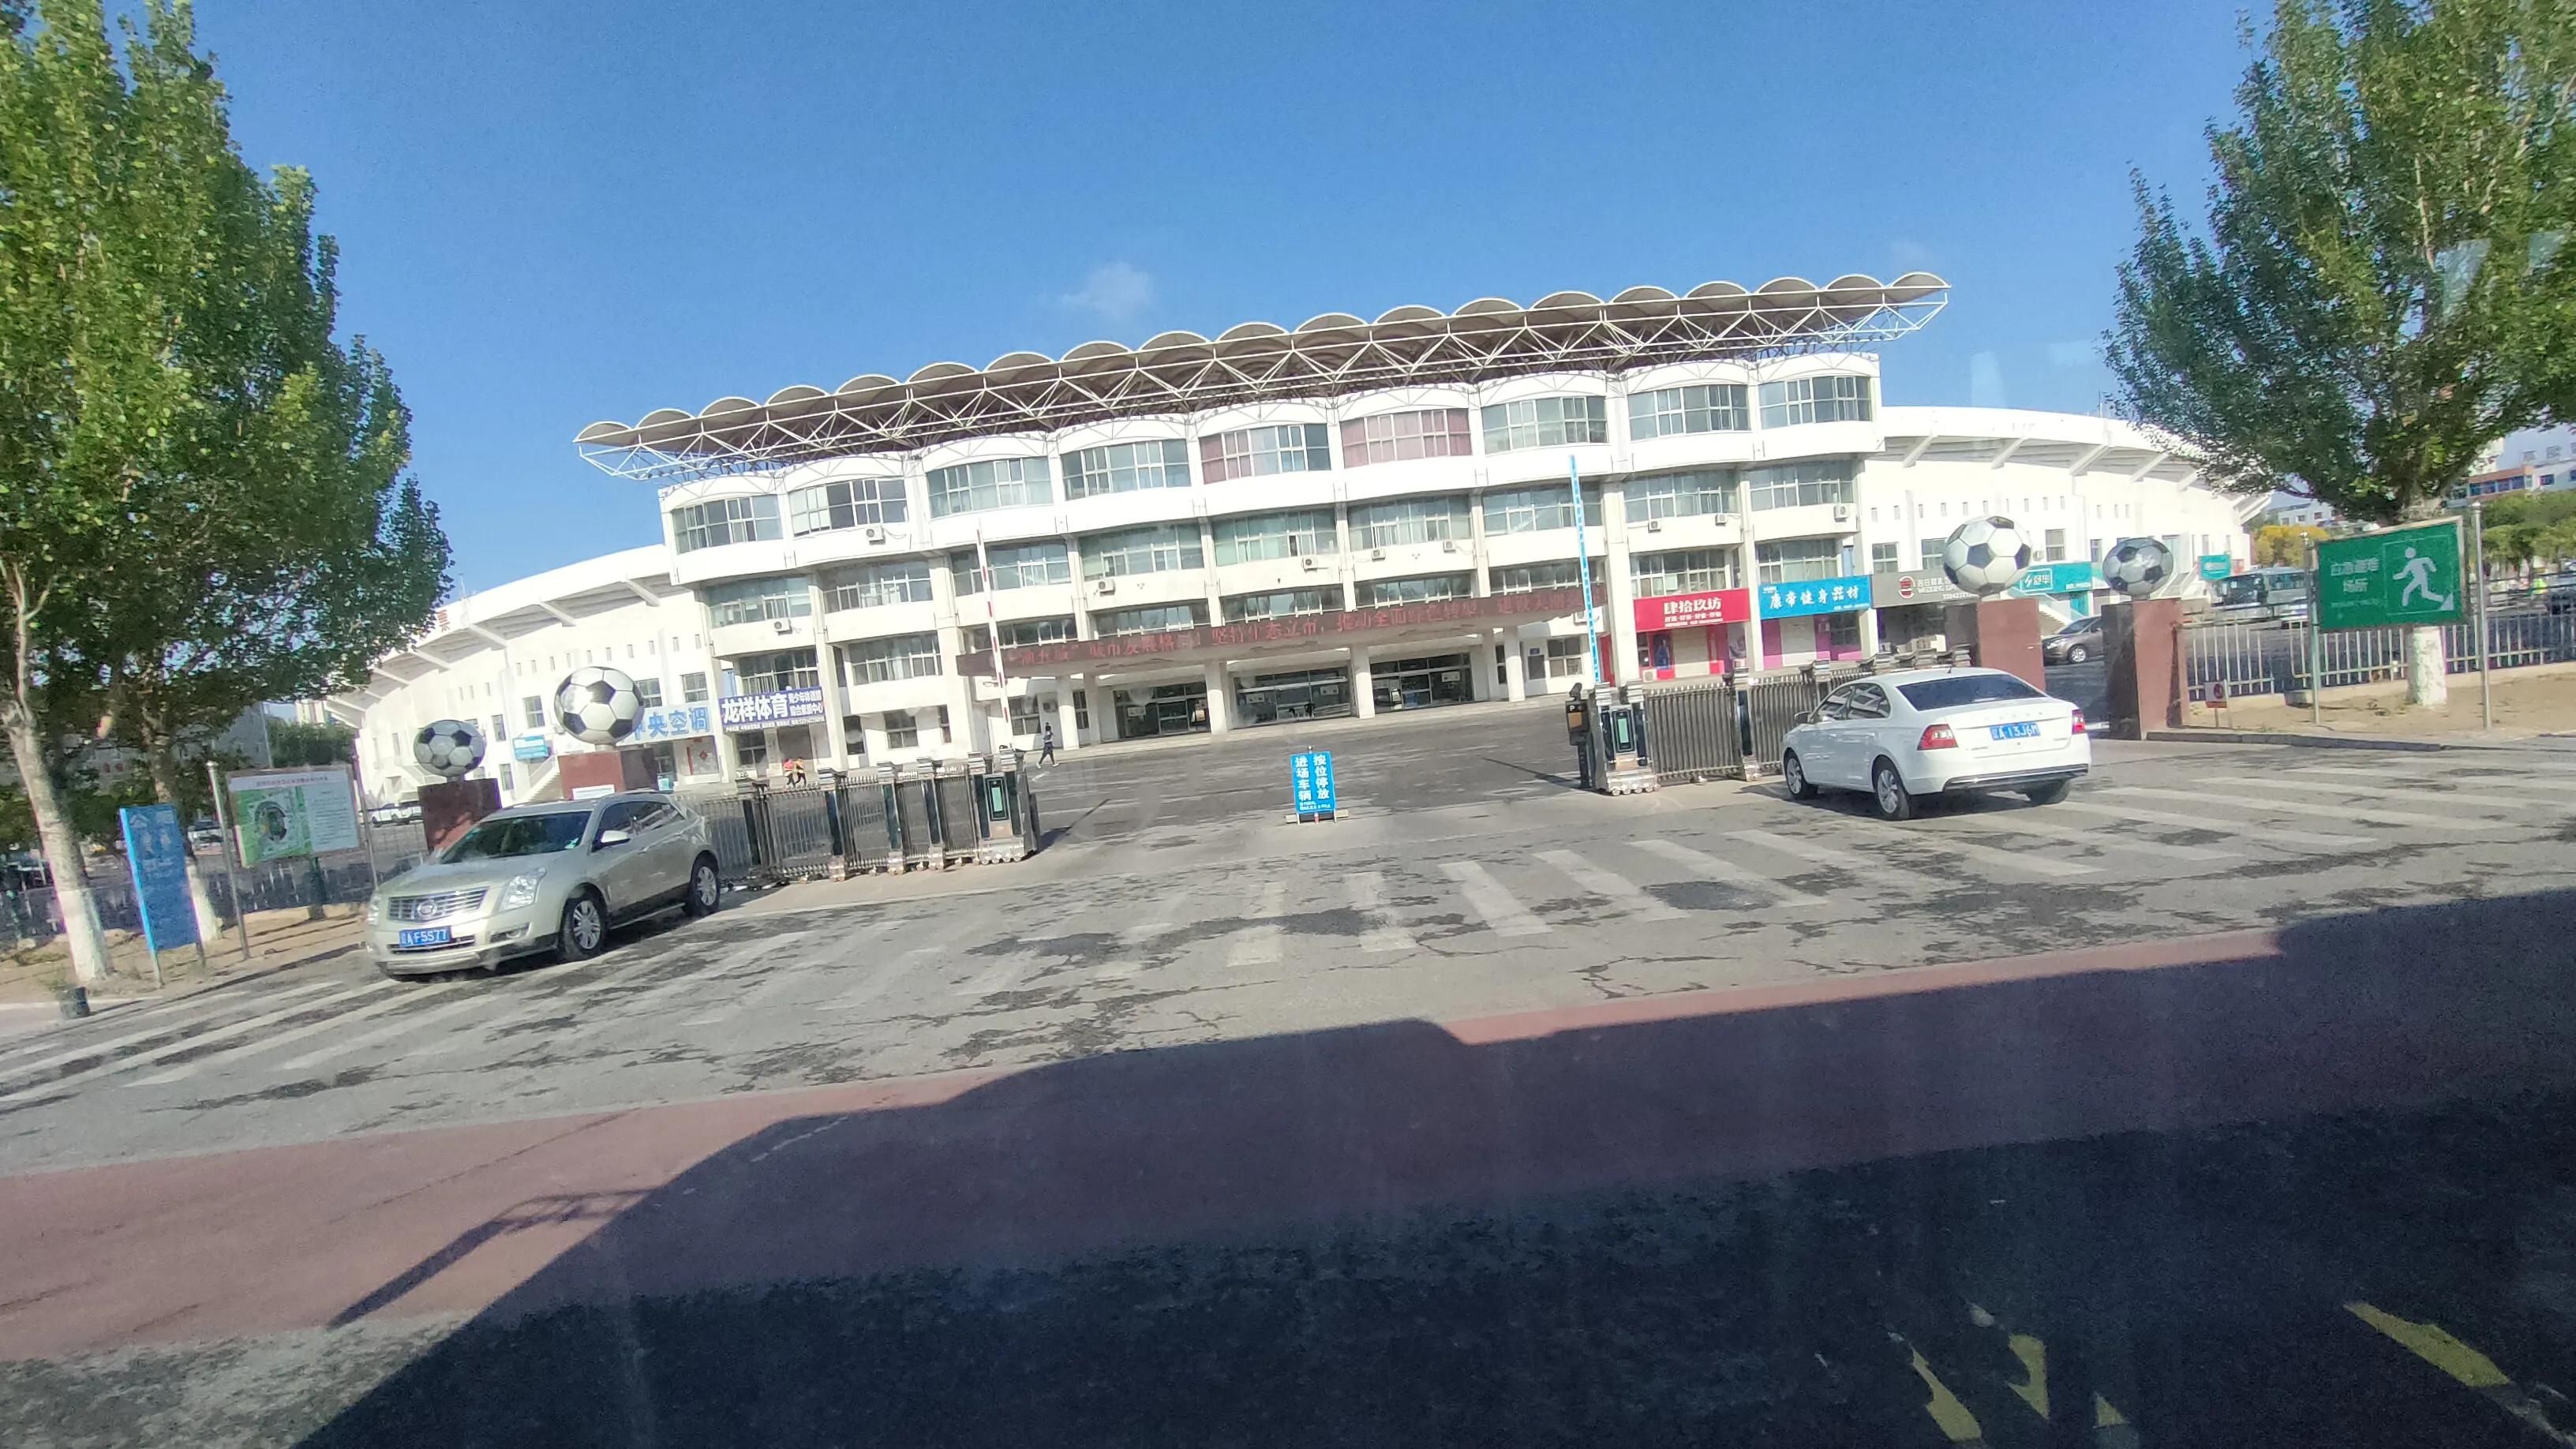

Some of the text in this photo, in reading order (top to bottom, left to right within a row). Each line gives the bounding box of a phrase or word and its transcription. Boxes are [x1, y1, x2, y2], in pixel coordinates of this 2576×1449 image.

[1664, 597, 1722, 614] 肆拾玖坊
[721, 693, 789, 724] 龙祥体育
[1295, 755, 1312, 801] 进场车辆
[1313, 754, 1330, 799] 按位停放
